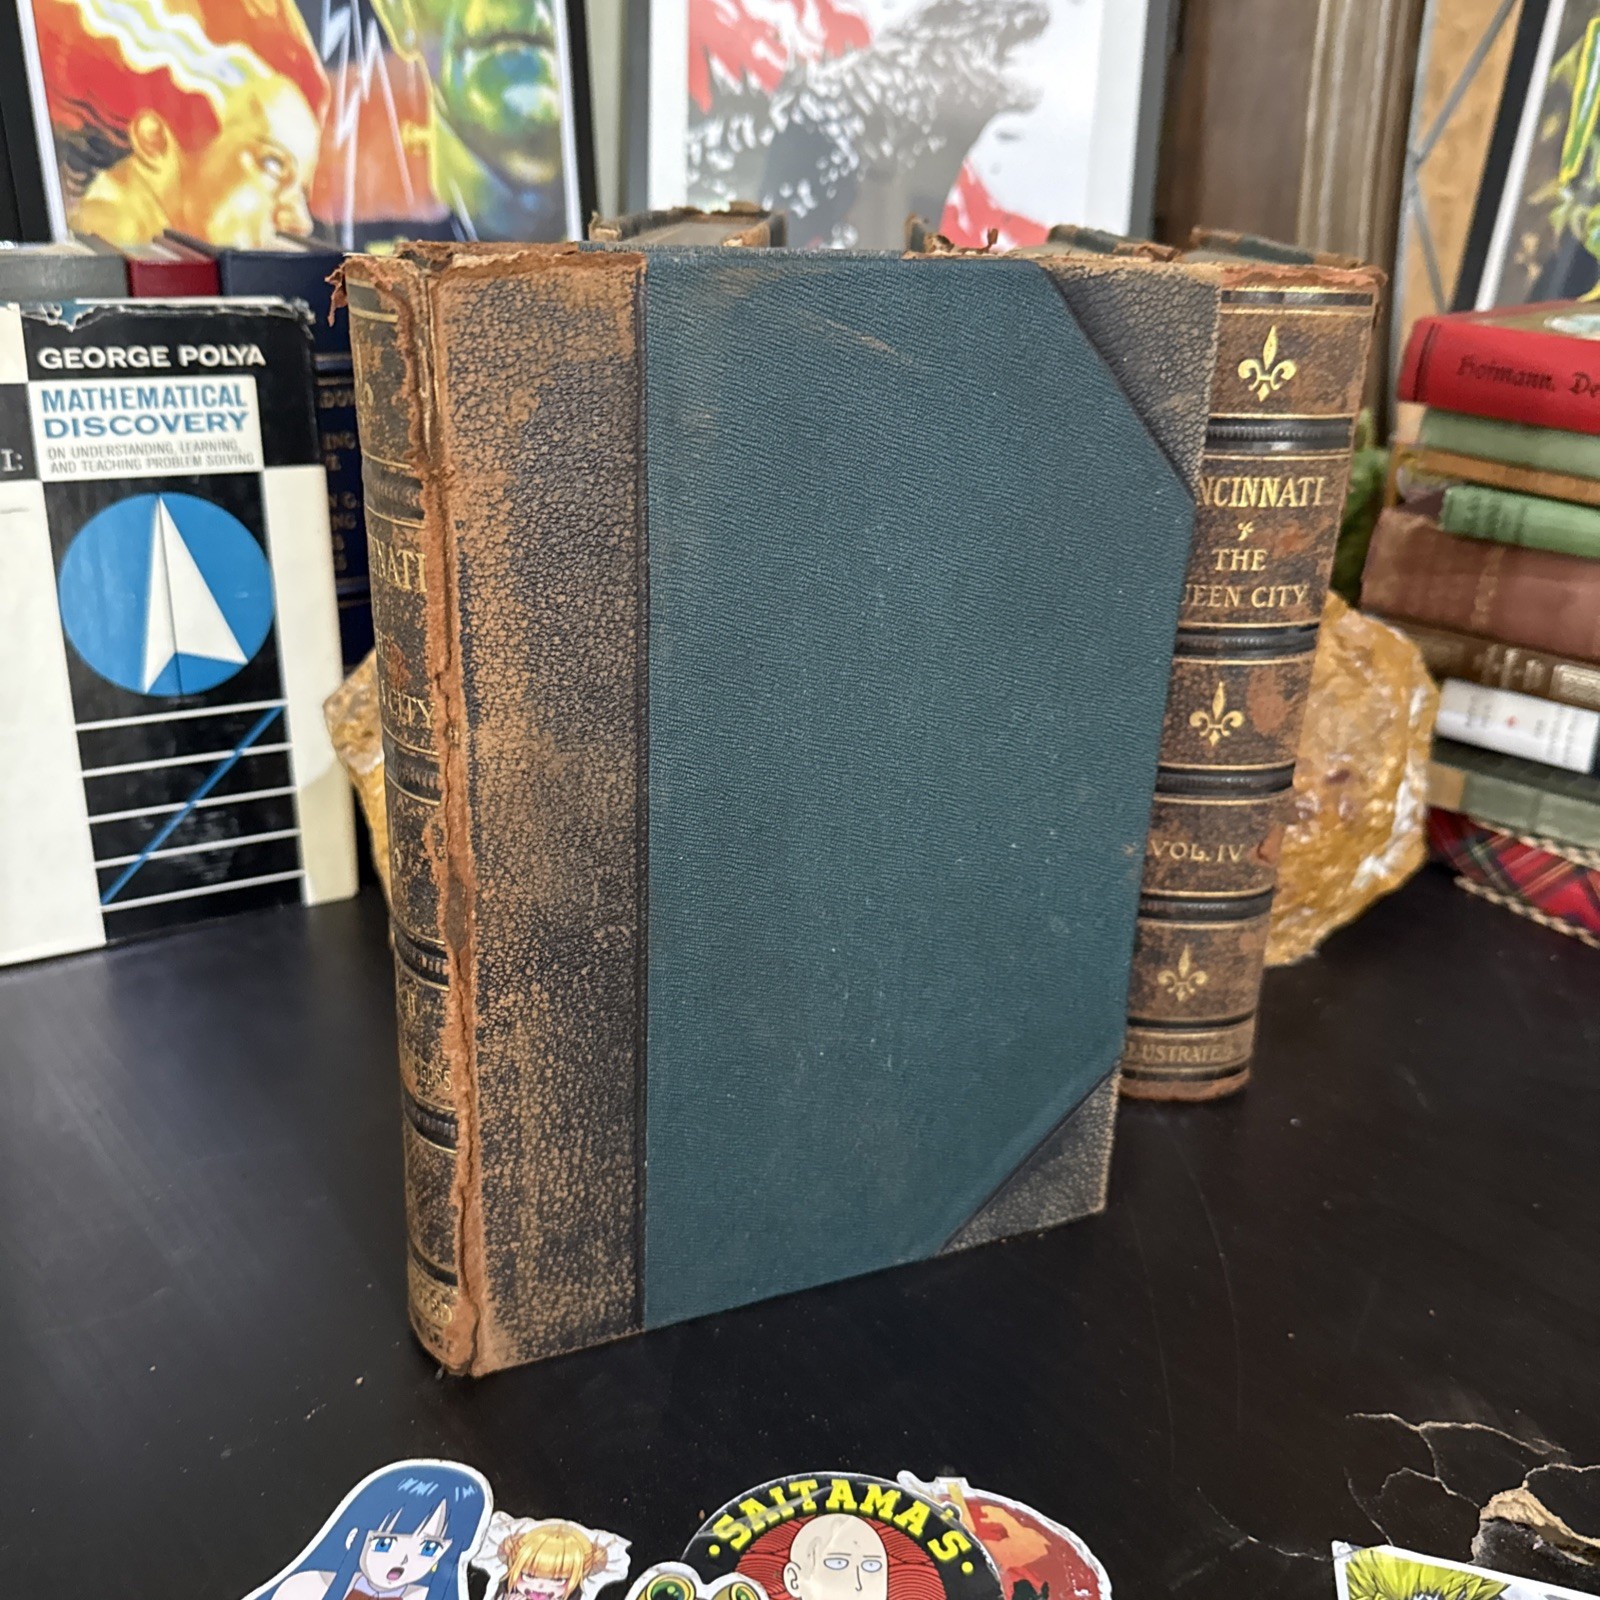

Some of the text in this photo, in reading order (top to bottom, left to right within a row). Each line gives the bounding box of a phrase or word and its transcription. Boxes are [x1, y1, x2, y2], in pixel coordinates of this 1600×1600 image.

[38, 344, 266, 370] GEORGE POLYA
[41, 383, 247, 413] MATHEMATICAL
[44, 412, 248, 439] DISCOVERY
[47, 446, 67, 461] ON
[50, 451, 255, 473] AND TEACHING PROBLEM SOLVING
[1211, 549, 1268, 572] THE
[1250, 584, 1310, 609] CITY
[1150, 841, 1246, 863] VOL. IV
[712, 1478, 972, 1562] SAITAMA'S
